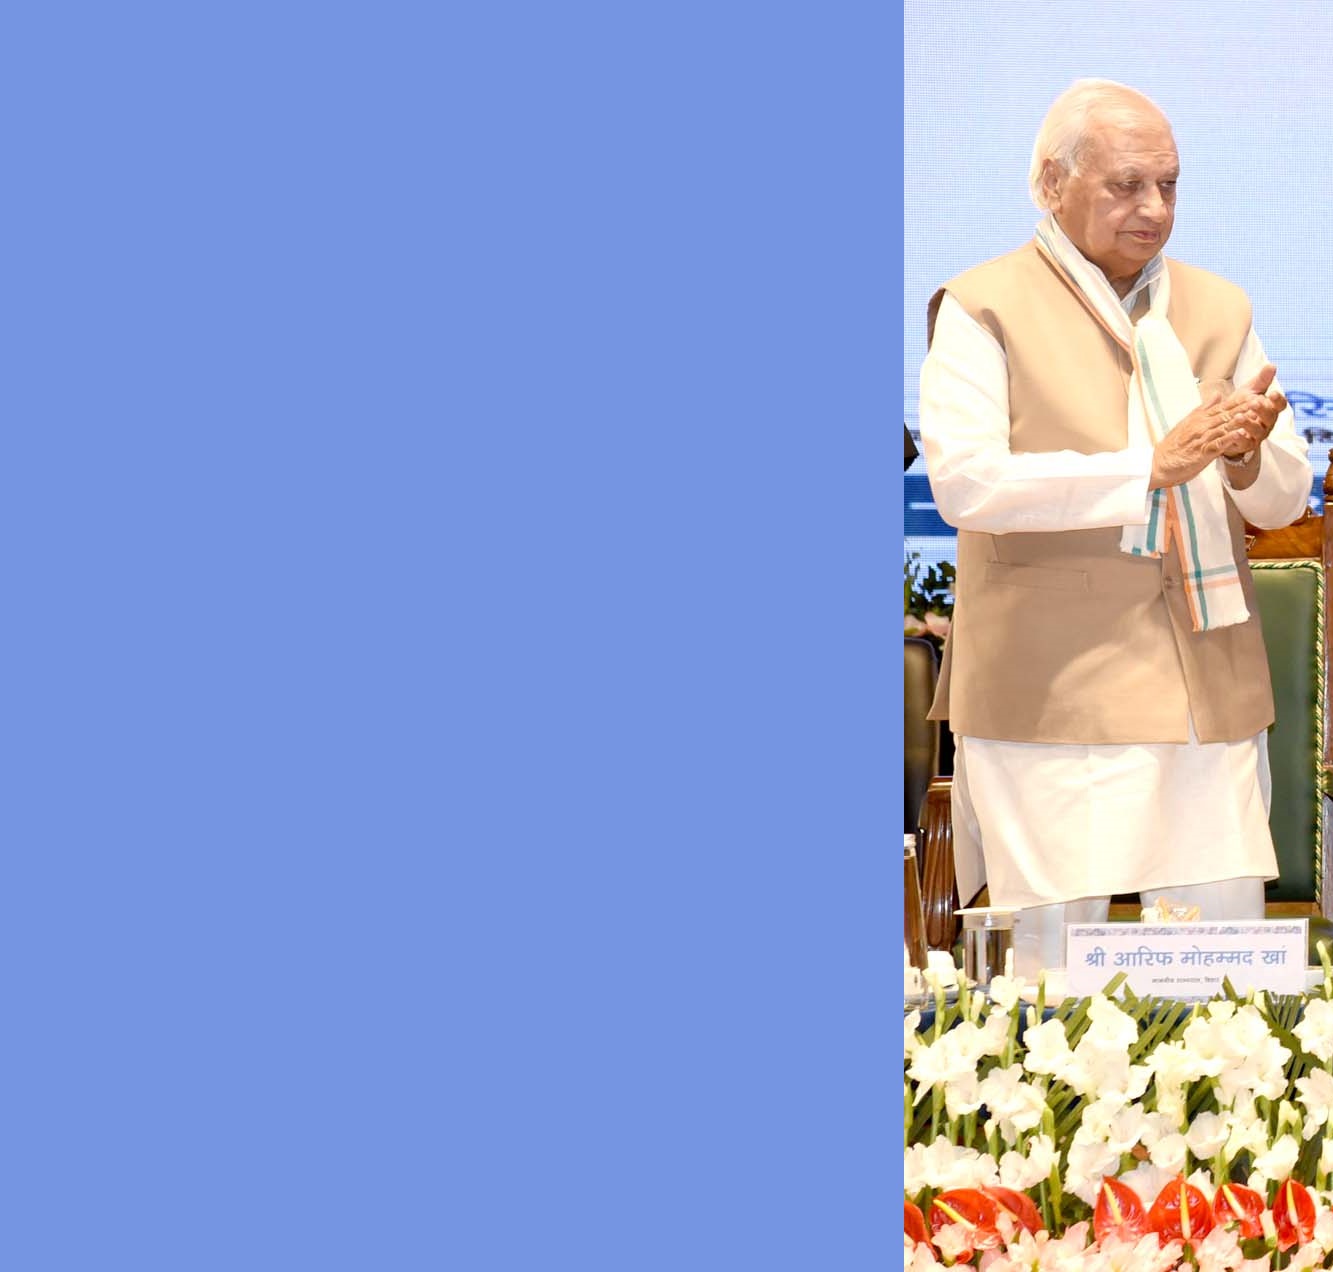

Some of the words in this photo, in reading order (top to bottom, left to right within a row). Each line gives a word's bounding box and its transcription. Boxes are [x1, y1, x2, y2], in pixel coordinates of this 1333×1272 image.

[1085, 945, 1106, 968] श्री
[1113, 945, 1173, 967] आरिफ
[1180, 945, 1254, 967] मोहम्मद
